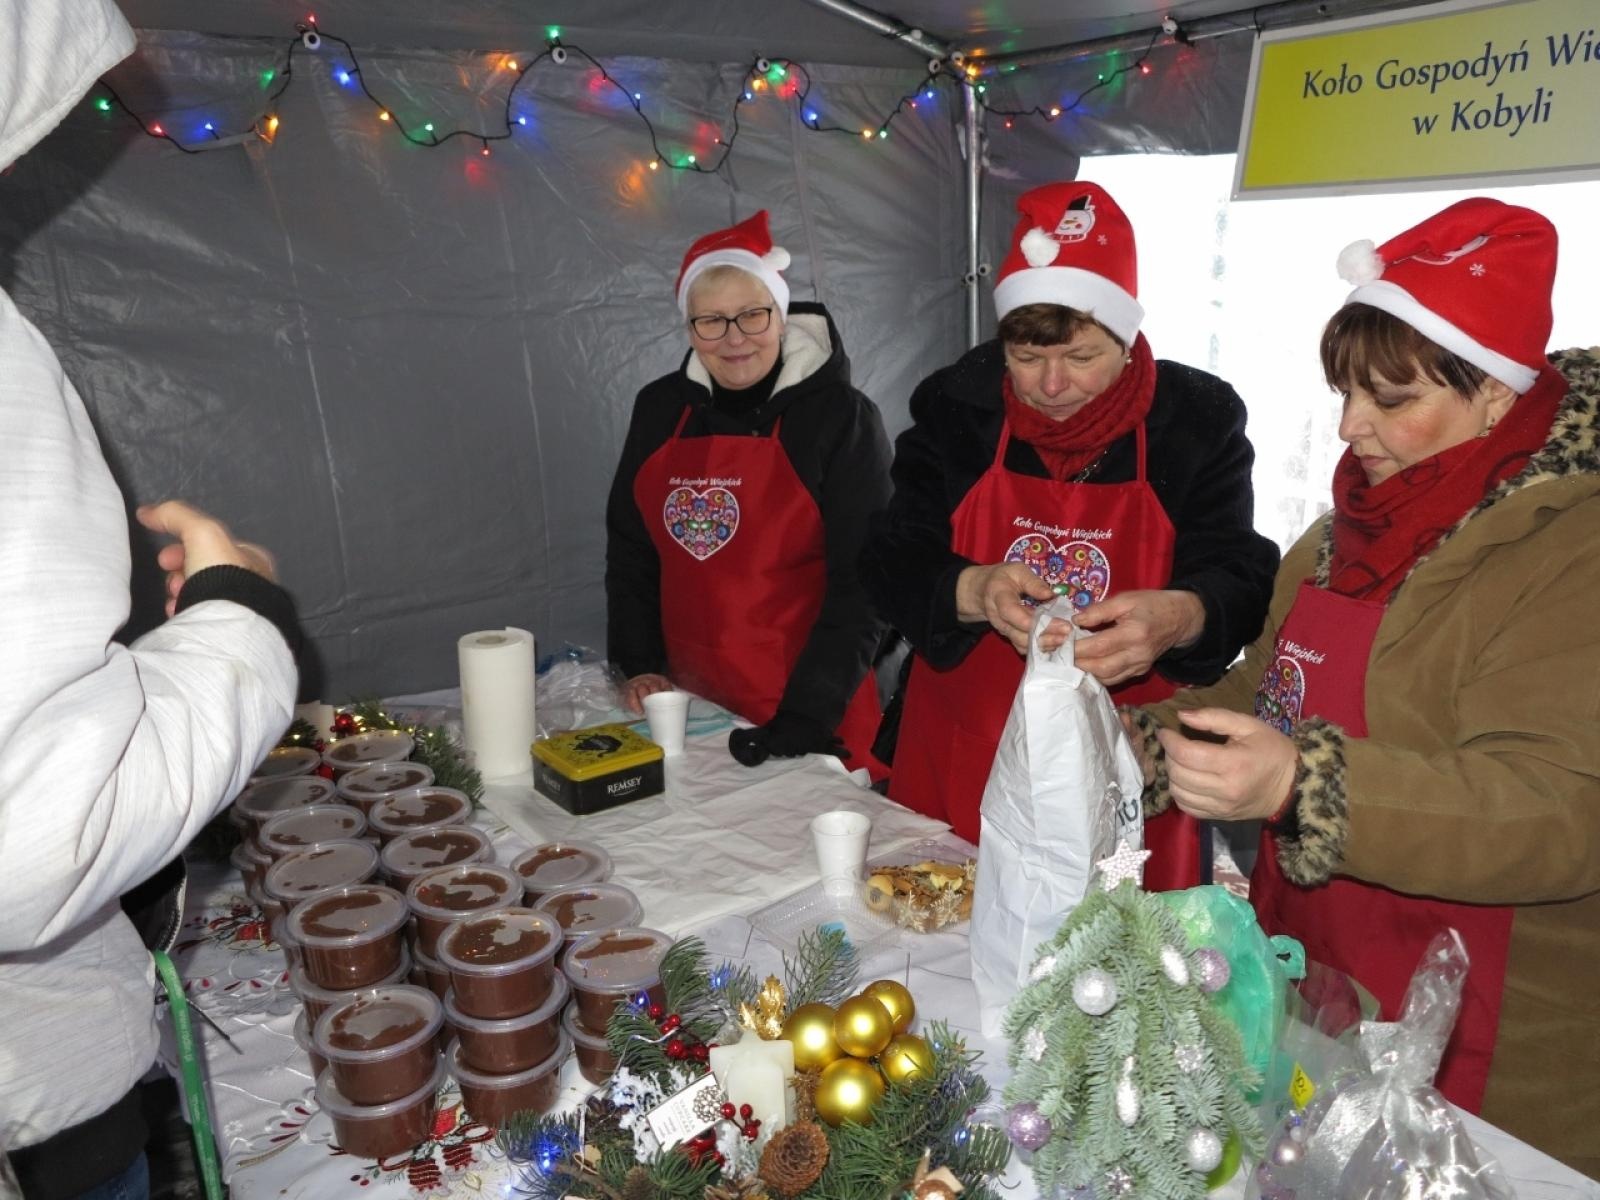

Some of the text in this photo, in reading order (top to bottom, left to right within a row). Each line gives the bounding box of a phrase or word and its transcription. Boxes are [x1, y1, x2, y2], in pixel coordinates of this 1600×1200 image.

[1303, 63, 1363, 98] Koło
[1376, 39, 1529, 94] Gospodyń
[1413, 88, 1554, 137] w Kobyli
[1071, 528, 1113, 542] Wiejskich
[607, 776, 642, 794] REMSEY
